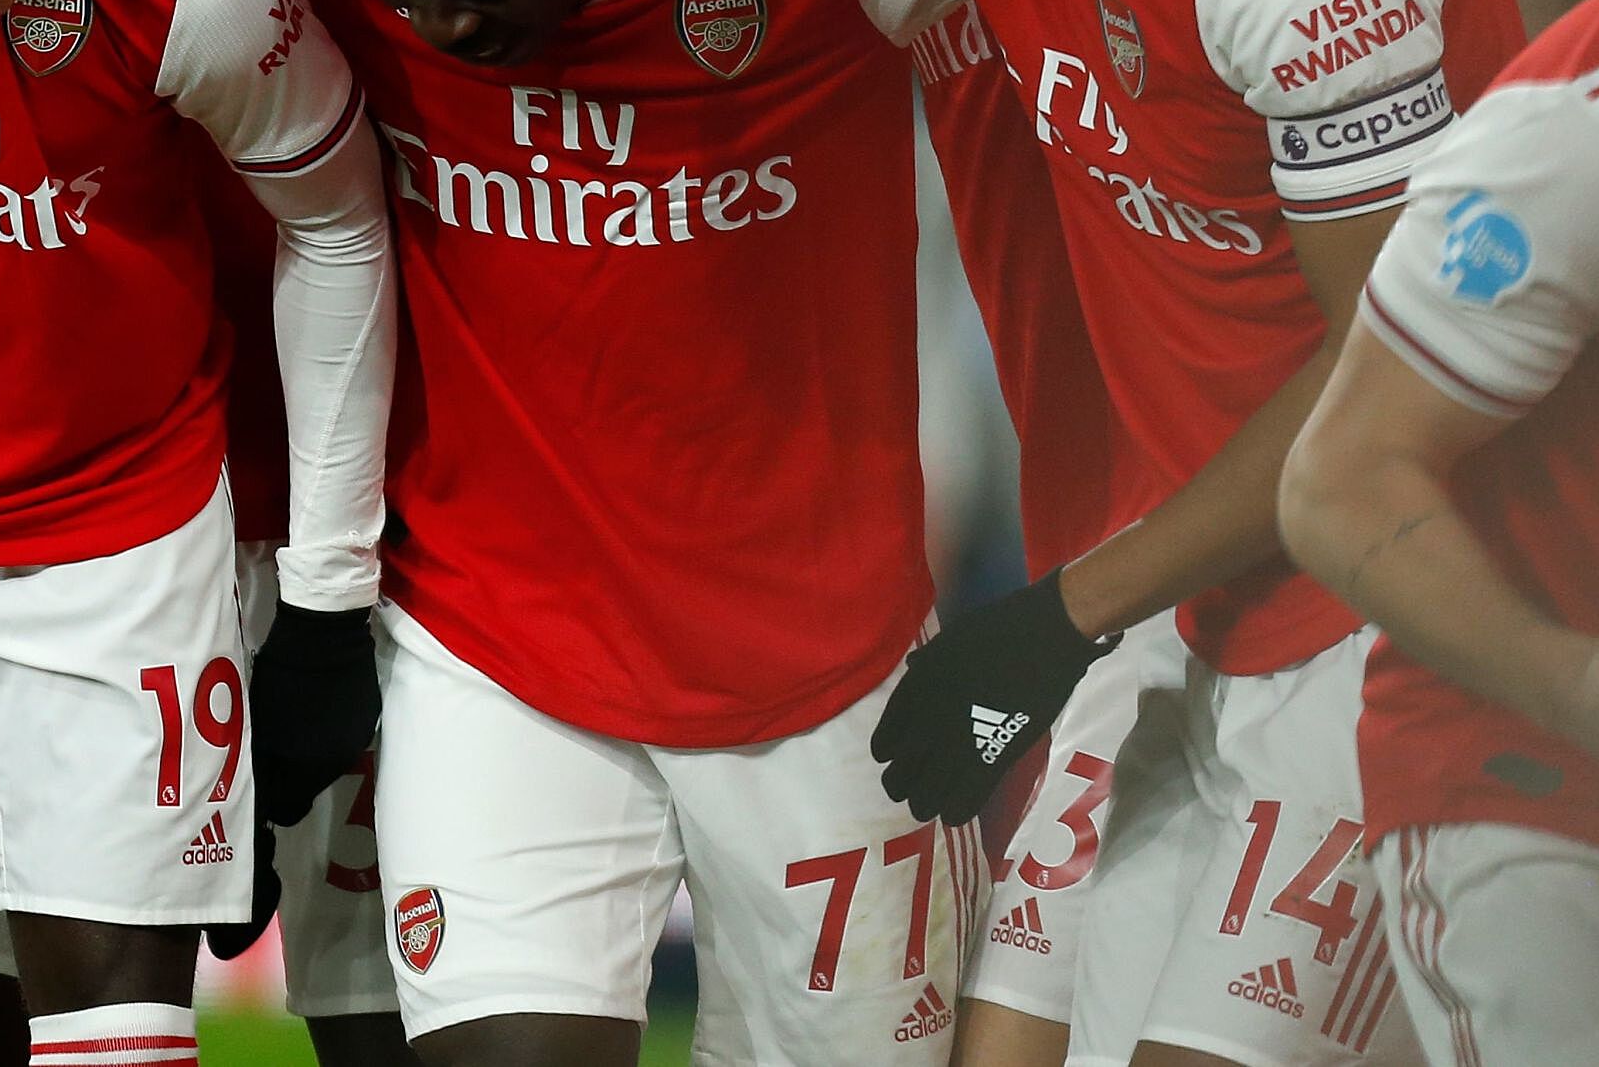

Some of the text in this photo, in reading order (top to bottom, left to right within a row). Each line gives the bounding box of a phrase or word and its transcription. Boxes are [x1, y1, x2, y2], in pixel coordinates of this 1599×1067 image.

[509, 85, 636, 167] Fly
[1037, 48, 1129, 156] Fly
[140, 656, 245, 808] 19
[982, 712, 1030, 764] adidas
[182, 843, 234, 865] adidas
[991, 750, 1115, 892] 3
[399, 897, 437, 925] Arsenal
[785, 819, 938, 993] 77
[1218, 800, 1366, 967] 14
[991, 926, 1052, 956] adidas
[894, 1008, 953, 1044] adidas
[1228, 980, 1306, 1019] adidas
